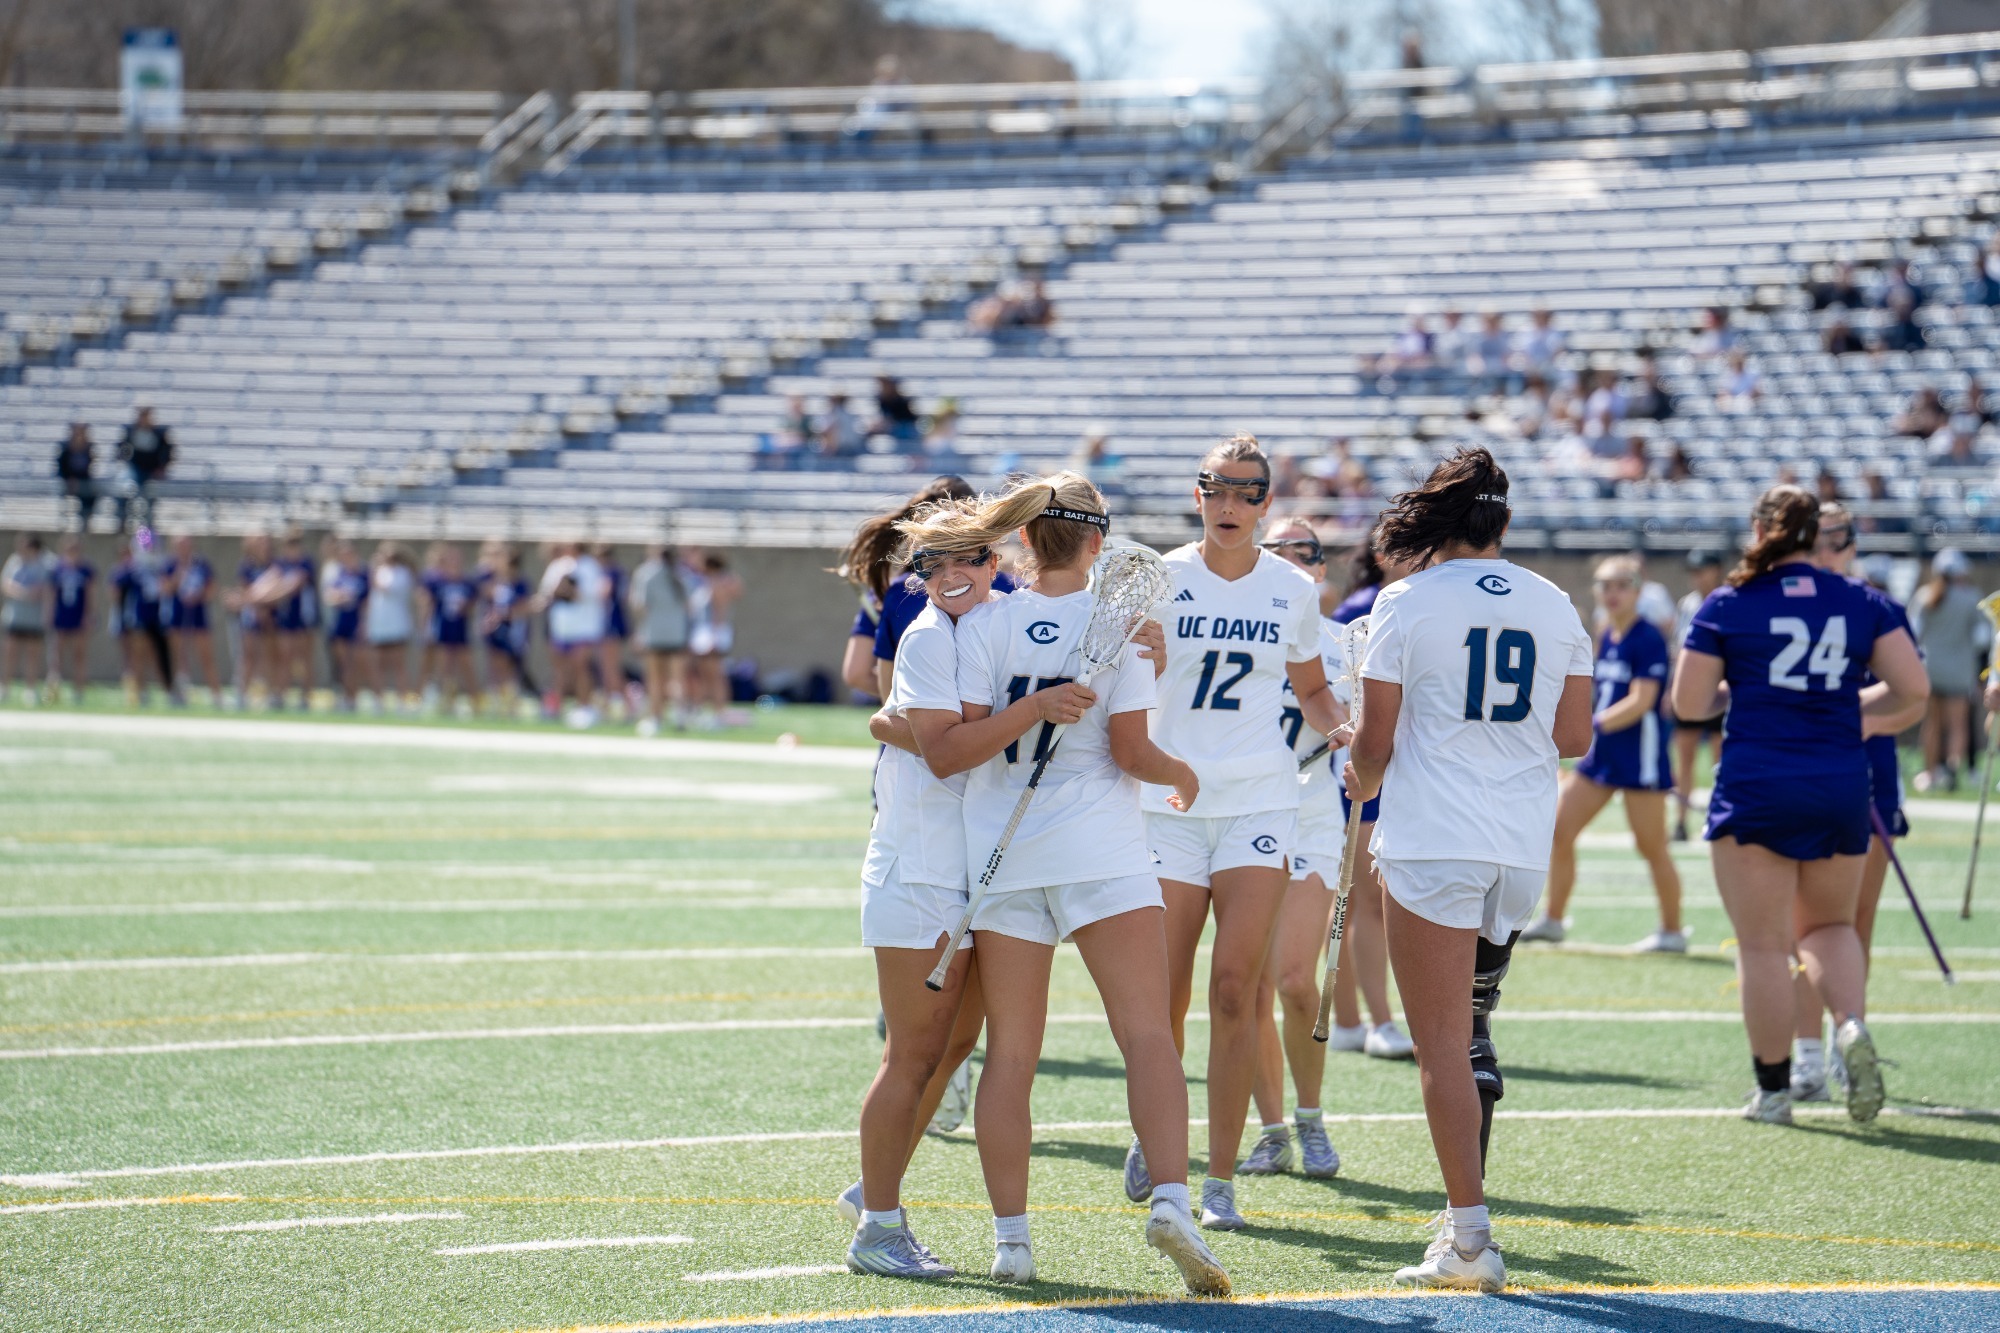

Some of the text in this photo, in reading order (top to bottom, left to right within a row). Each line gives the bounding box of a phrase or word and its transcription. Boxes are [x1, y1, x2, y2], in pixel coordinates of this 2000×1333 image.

[1064, 511, 1086, 521] GAIT
[1177, 616, 1281, 644] UC DAVIS
[1769, 615, 1850, 692] 24
[1190, 649, 1254, 712] 12
[1461, 626, 1538, 724] 19
